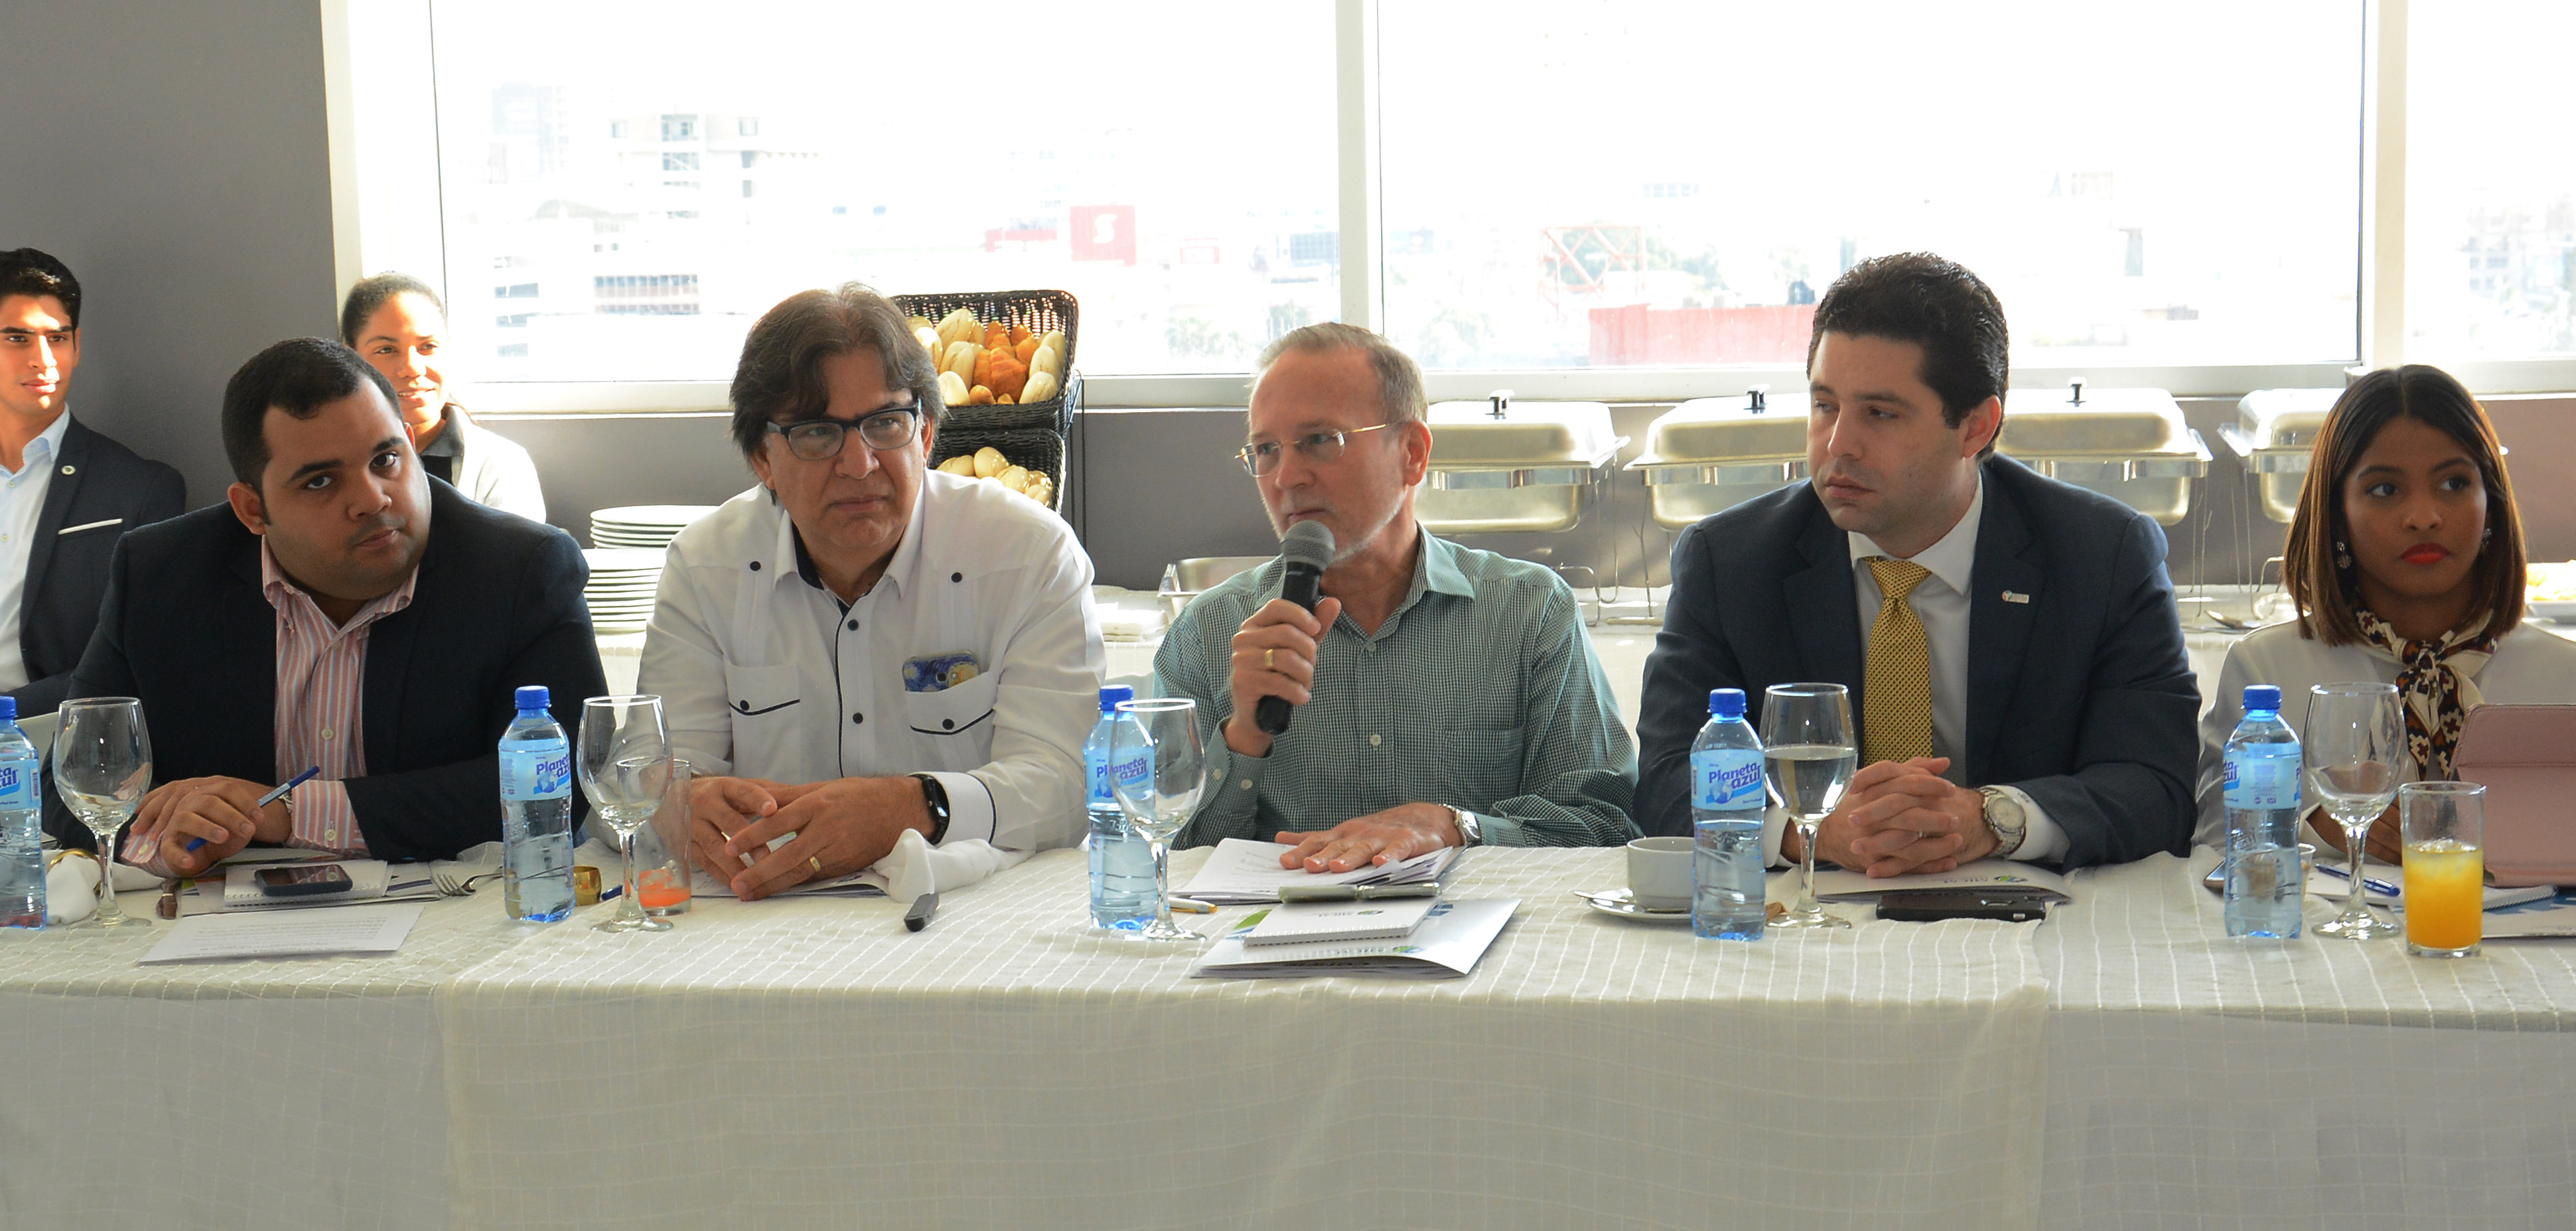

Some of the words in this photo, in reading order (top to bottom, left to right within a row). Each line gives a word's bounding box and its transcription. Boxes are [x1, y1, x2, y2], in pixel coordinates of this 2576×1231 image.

[1119, 759, 1147, 779] azul
[1709, 762, 1757, 784] Planeta
[1731, 764, 1762, 789] azul
